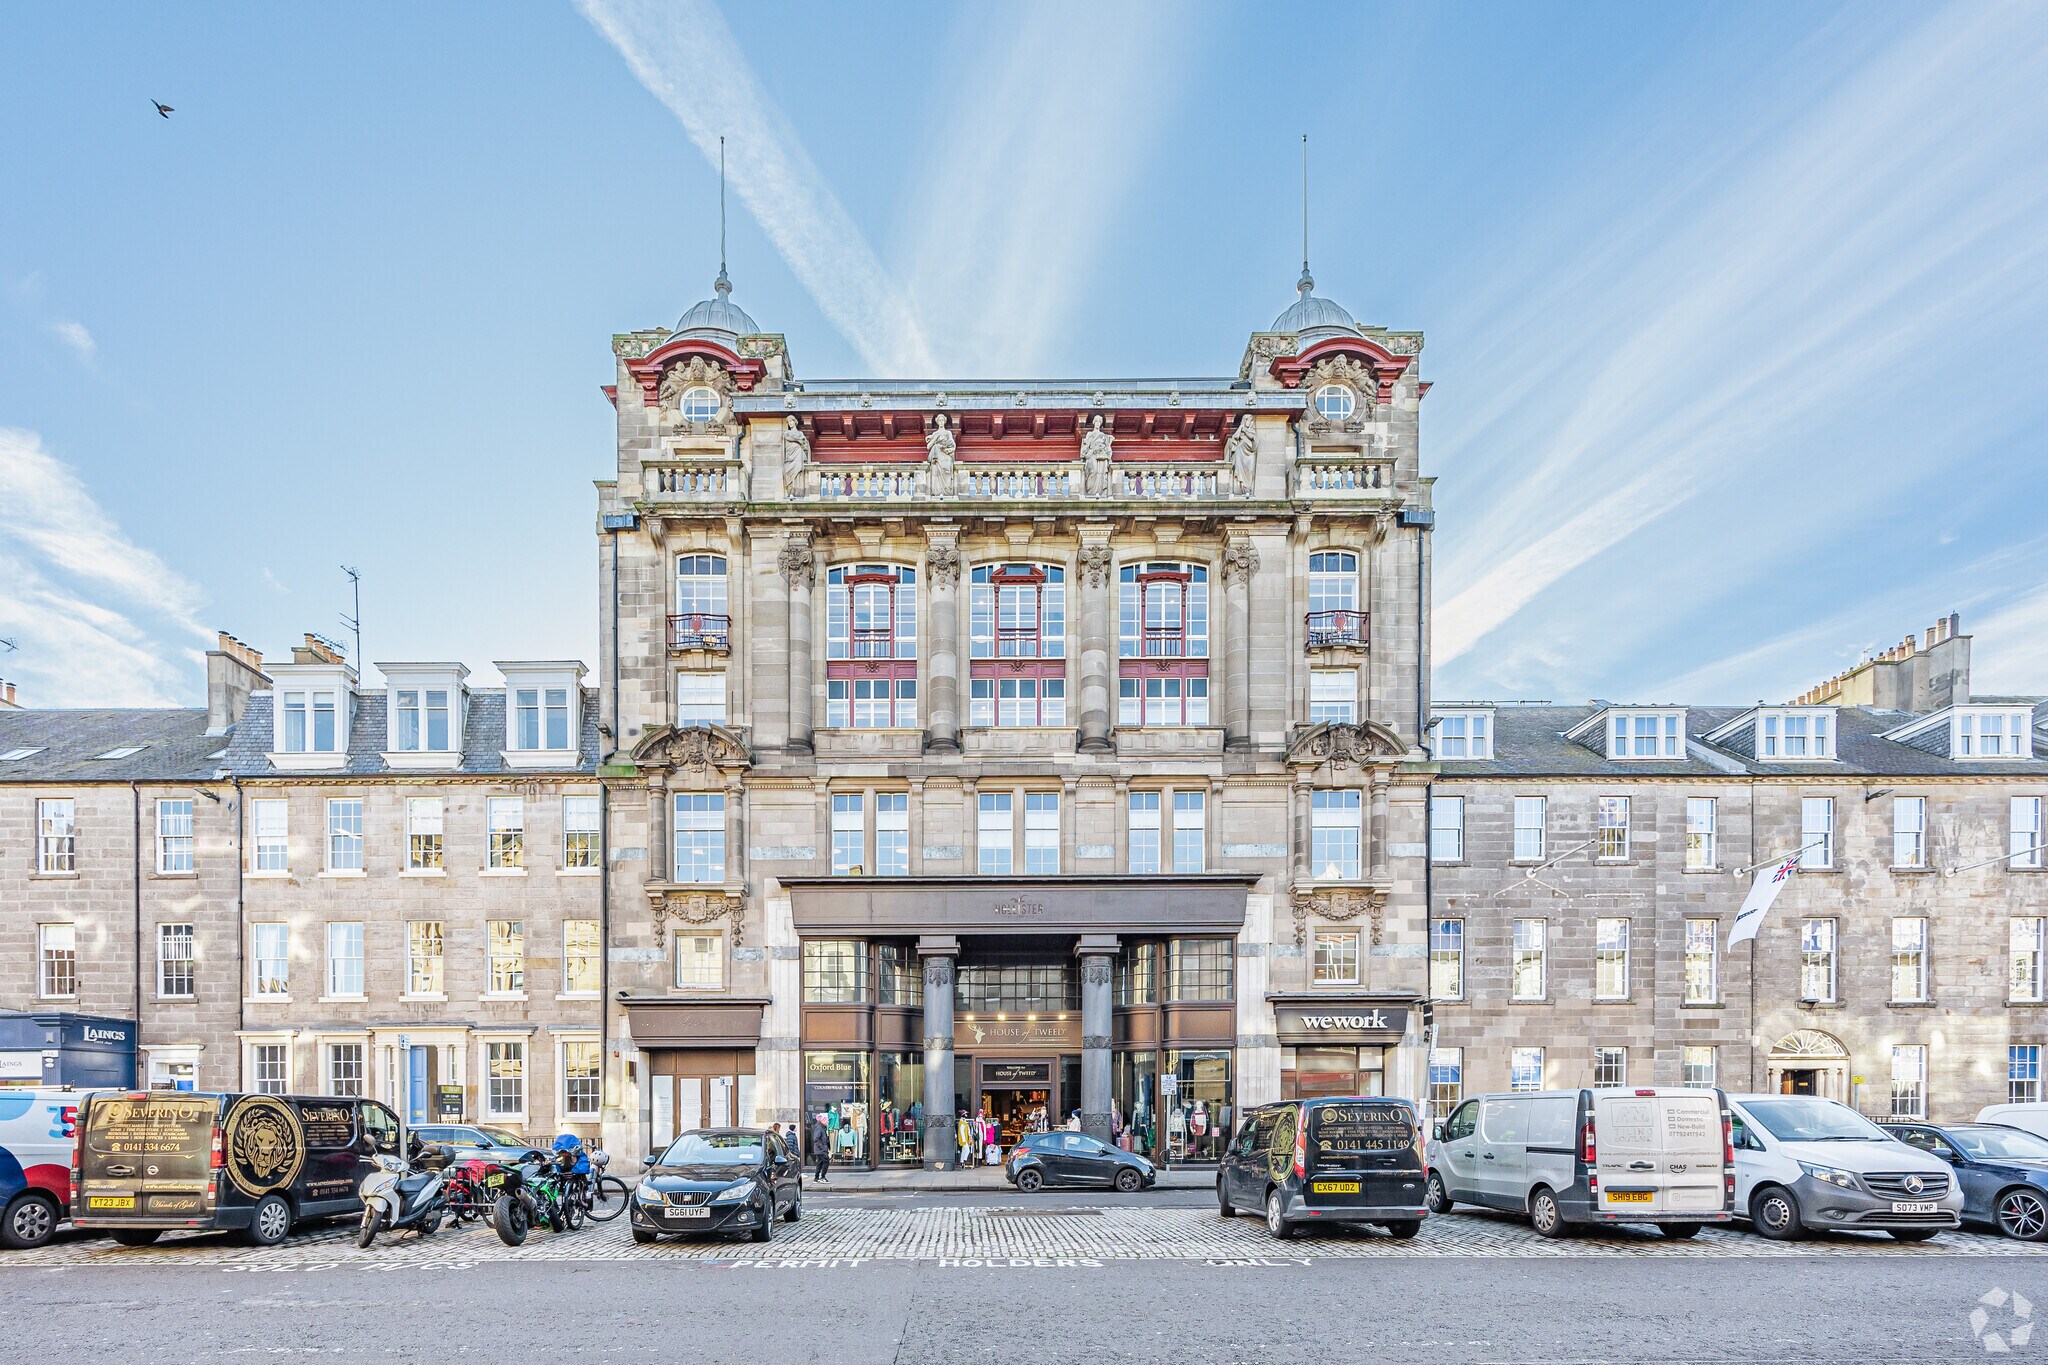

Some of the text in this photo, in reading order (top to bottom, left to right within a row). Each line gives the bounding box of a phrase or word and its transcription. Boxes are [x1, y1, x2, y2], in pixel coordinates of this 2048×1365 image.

[995, 904, 1043, 915] HOLLISTER
[1301, 1009, 1388, 1029] wework
[83, 1025, 125, 1041] LAINGS
[989, 1028, 1019, 1036] HOUSE
[1016, 1024, 1035, 1045] of
[1034, 1028, 1064, 1036] TWEED
[810, 1063, 852, 1073] Oxford Blue
[1009, 1068, 1020, 1080] of
[124, 1103, 193, 1118] SEVERINO
[302, 1107, 350, 1122] SEVERINO
[1338, 1109, 1402, 1123] SEVERINO
[123, 1143, 180, 1151] 0141 334 6674
[1337, 1140, 1410, 1149] 0141 445 1149
[1612, 1193, 1648, 1201] SH19 EBG
[151, 1199, 173, 1208] Hands
[179, 1199, 197, 1210] Gold
[1896, 1203, 1934, 1211] SO73 VMP
[669, 1208, 705, 1216] SG61 UYF
[729, 1259, 870, 1268] PERMIT
[938, 1259, 1105, 1267] HOLDERS
[1205, 1258, 1312, 1266] ONLY
